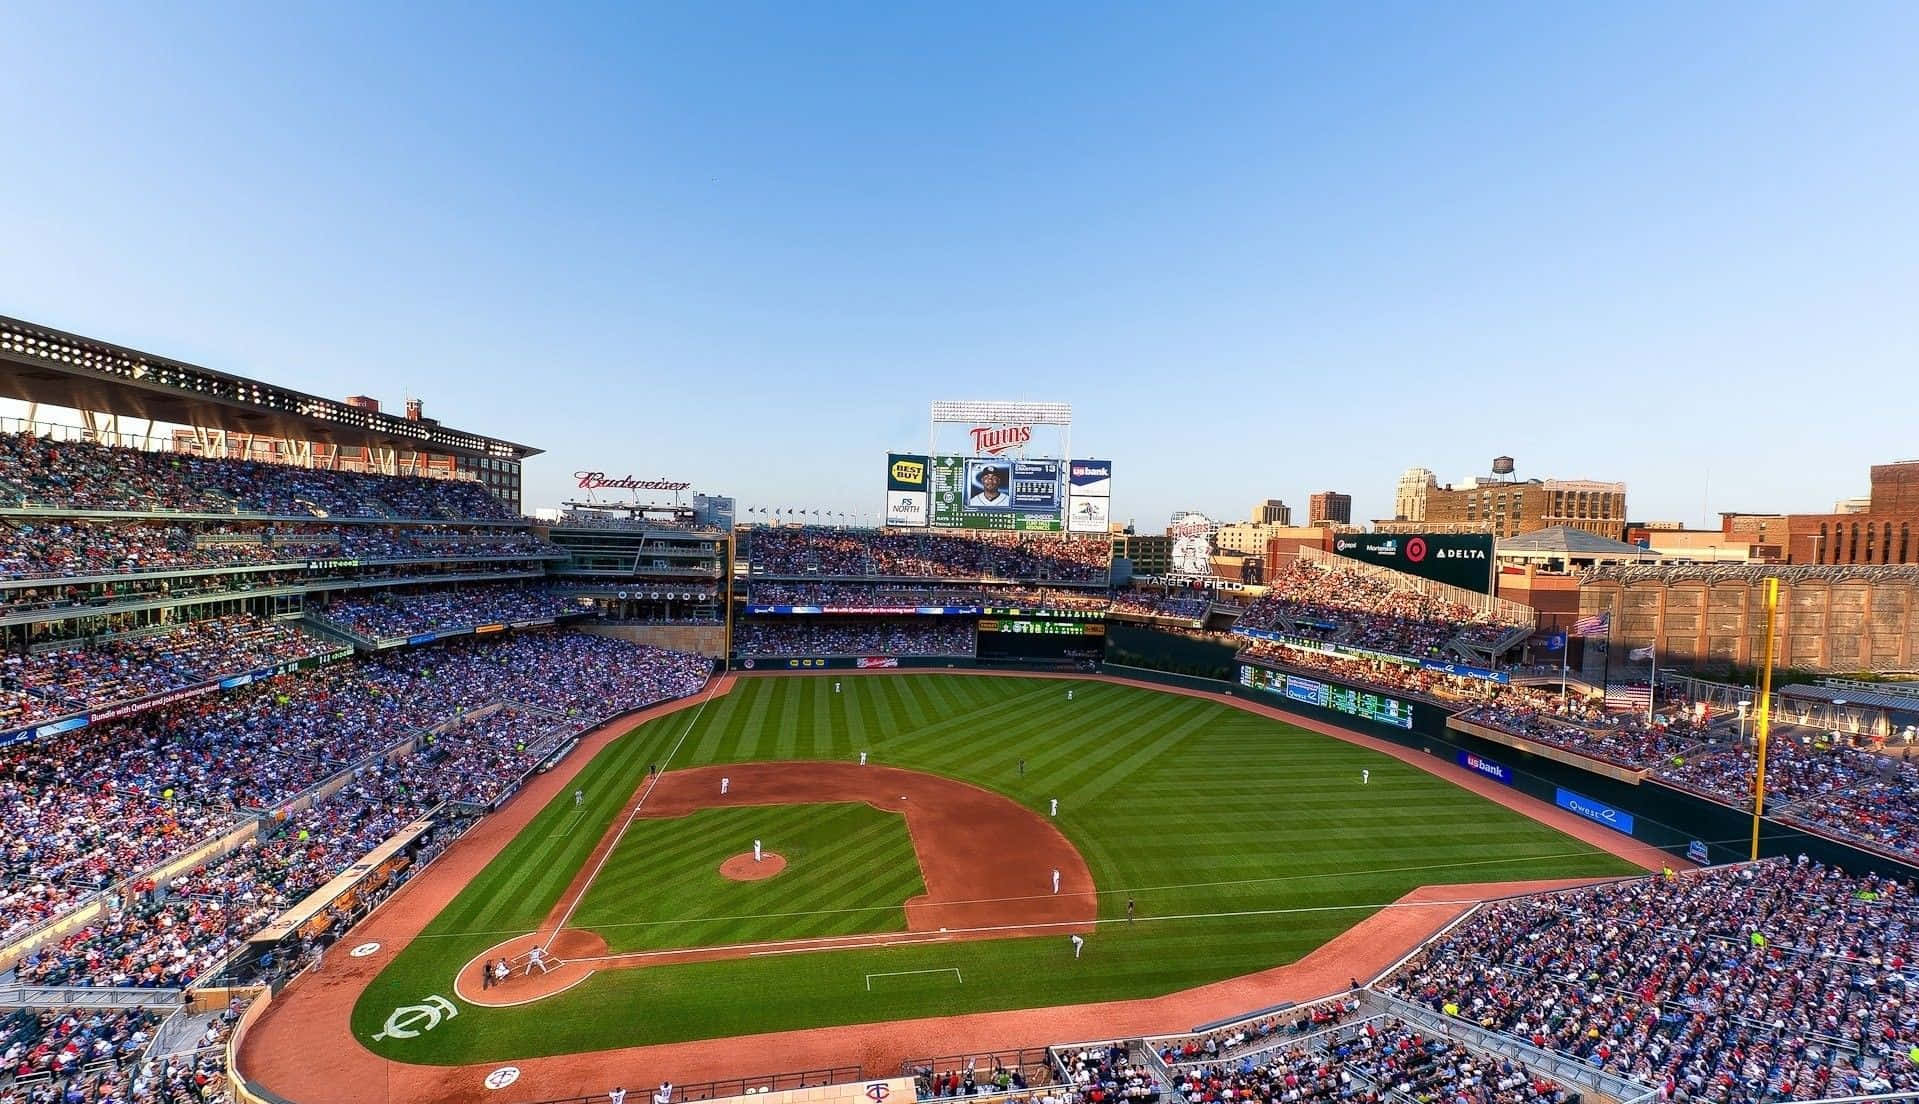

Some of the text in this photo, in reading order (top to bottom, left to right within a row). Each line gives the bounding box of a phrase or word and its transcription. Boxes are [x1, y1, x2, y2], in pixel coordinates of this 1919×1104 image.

[970, 425, 1032, 452] Twins
[897, 465, 921, 473] BEST
[574, 471, 690, 490] Budweiser
[1448, 550, 1485, 559] DELTA
[1146, 576, 1243, 591] TARGET FIELD
[91, 711, 116, 722] Bundle
[116, 705, 131, 715] with
[131, 702, 152, 712] Qwest
[1569, 800, 1600, 818] Qwest
